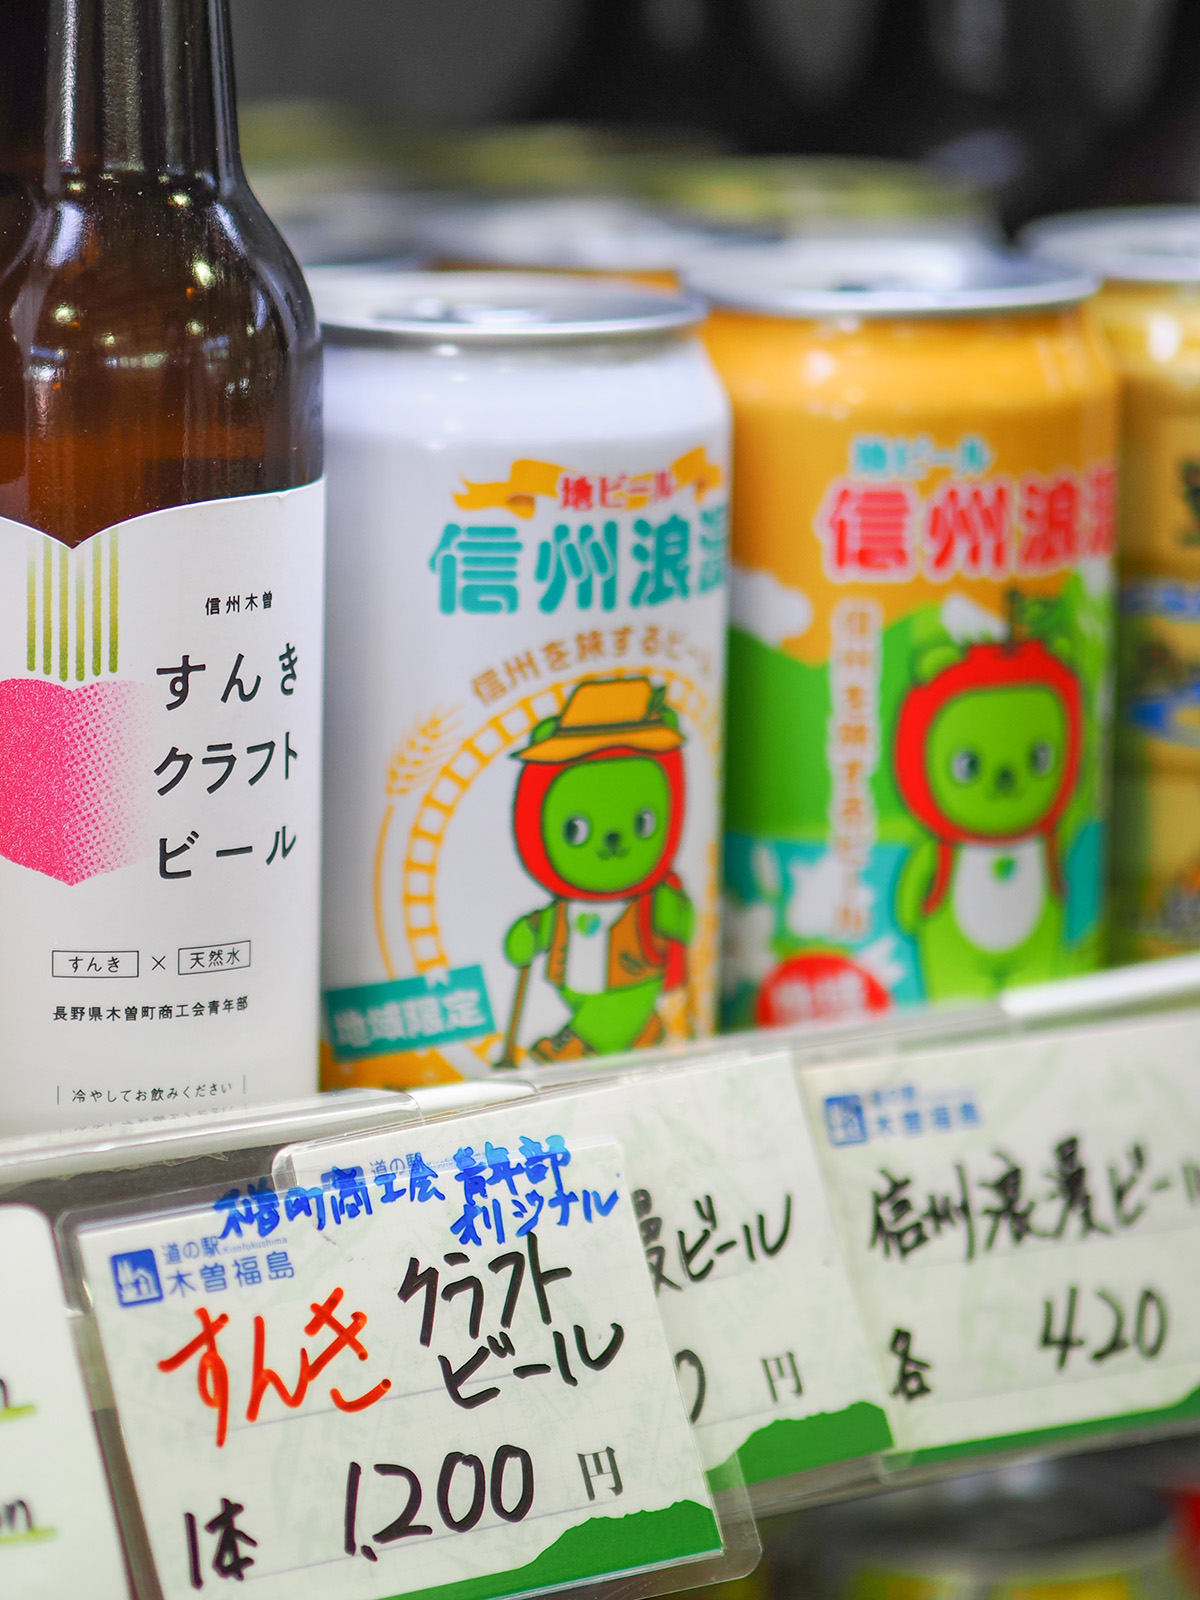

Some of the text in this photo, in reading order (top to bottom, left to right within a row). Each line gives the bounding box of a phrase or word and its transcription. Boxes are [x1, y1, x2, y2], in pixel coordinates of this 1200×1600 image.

[204, 590, 274, 616] 信州木曽
[156, 642, 298, 711] すんき
[153, 731, 299, 797] クラフト
[158, 825, 297, 880] ビール
[67, 956, 121, 974] すんき
[189, 946, 241, 971] 天然水
[52, 995, 249, 1022] 長野県木曽町商工会青年部
[71, 1081, 233, 1105] 冷やしてお飲みください
[450, 1186, 620, 1247] オリジナル
[161, 1236, 288, 1266] 道の駅 Kisofukushima
[166, 1251, 296, 1298] 木曽福島
[398, 1231, 572, 1346] クラフト
[1040, 1286, 1169, 1373] 420
[157, 1286, 392, 1448] すんき
[438, 1321, 624, 1409] ビール
[761, 1351, 803, 1404] 円
[184, 1498, 257, 1589] 1本
[576, 1445, 624, 1501] 円
